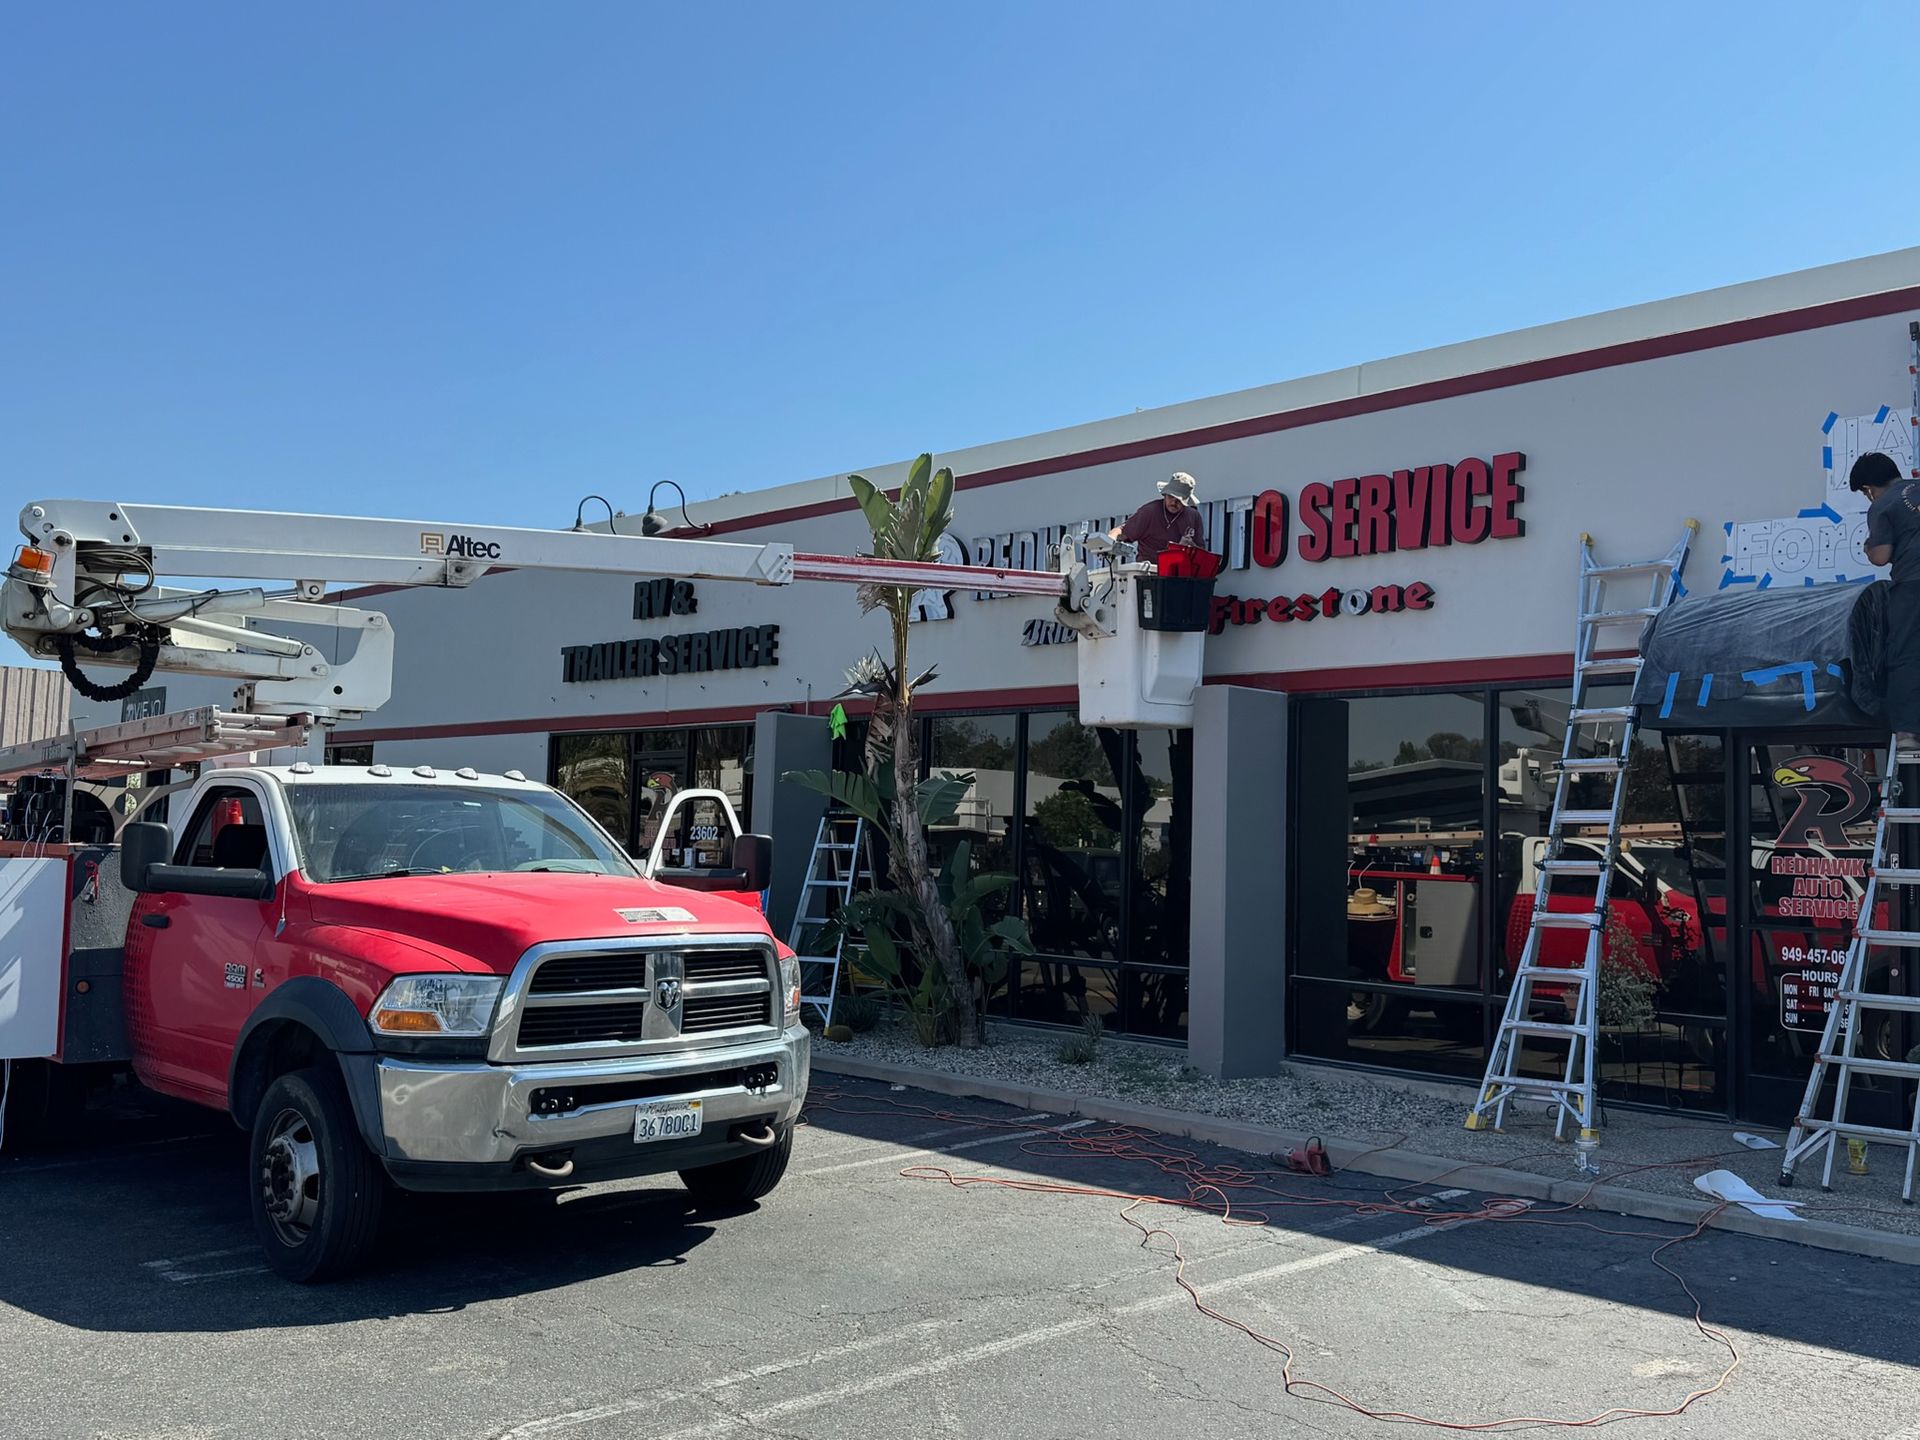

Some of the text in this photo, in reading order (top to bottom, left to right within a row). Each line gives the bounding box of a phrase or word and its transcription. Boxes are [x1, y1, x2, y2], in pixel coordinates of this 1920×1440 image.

[1196, 489, 1289, 575] UTO
[1298, 451, 1526, 562] SERVICE
[446, 534, 501, 559] Altec
[633, 578, 698, 620] RV &
[1207, 581, 1436, 635] Firestone
[561, 624, 780, 683] TRAILER SERVICE
[690, 826, 718, 840] 23602
[1771, 856, 1866, 877] REDHAWK
[1792, 878, 1843, 898] AUTO
[1778, 897, 1858, 920] SERVICE
[1781, 946, 1849, 965] 949-457-06
[226, 975, 245, 984] 4500
[1802, 969, 1839, 983] HOURS
[1783, 984, 1798, 995] MON
[1808, 985, 1820, 997] FRI
[1785, 998, 1798, 1010] SAT
[1784, 1012, 1798, 1024] SUN
[650, 1104, 692, 1115] California
